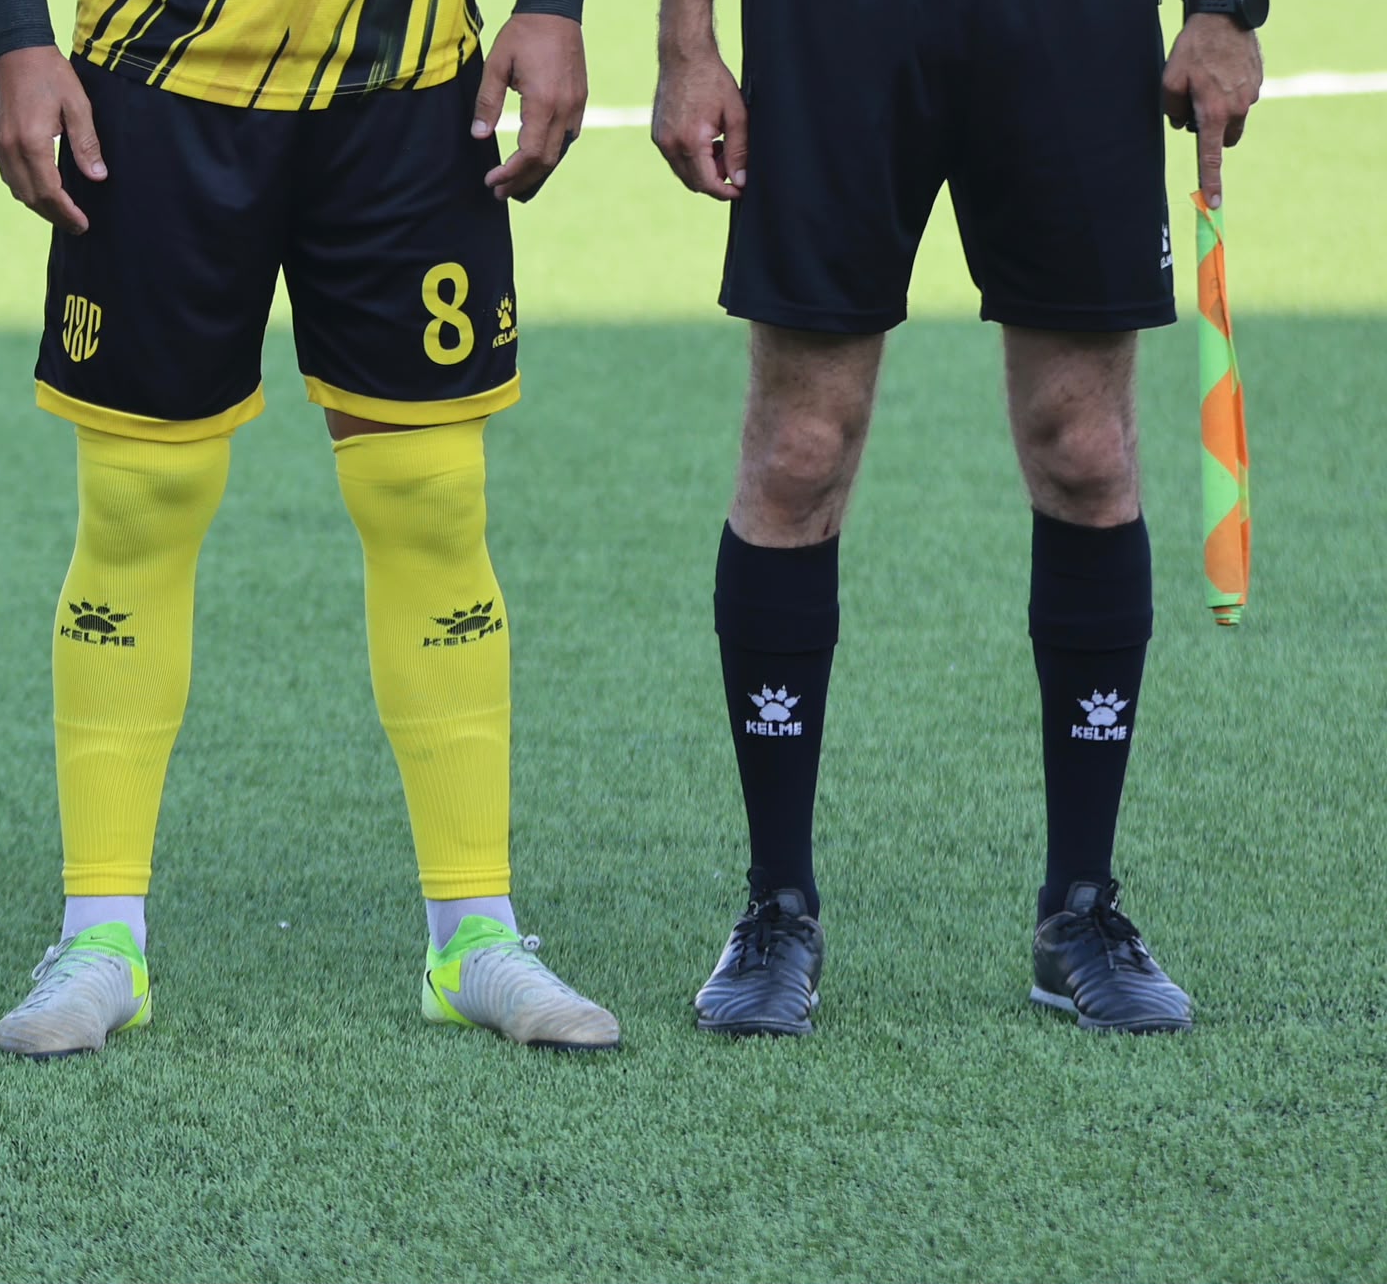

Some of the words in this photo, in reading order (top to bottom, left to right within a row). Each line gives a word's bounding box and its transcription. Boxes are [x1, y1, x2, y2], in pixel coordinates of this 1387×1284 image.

[422, 262, 474, 365] 8
[60, 625, 136, 647] KELME
[423, 618, 503, 647] KELME
[745, 720, 802, 736] KELME
[1071, 725, 1127, 741] KELME
